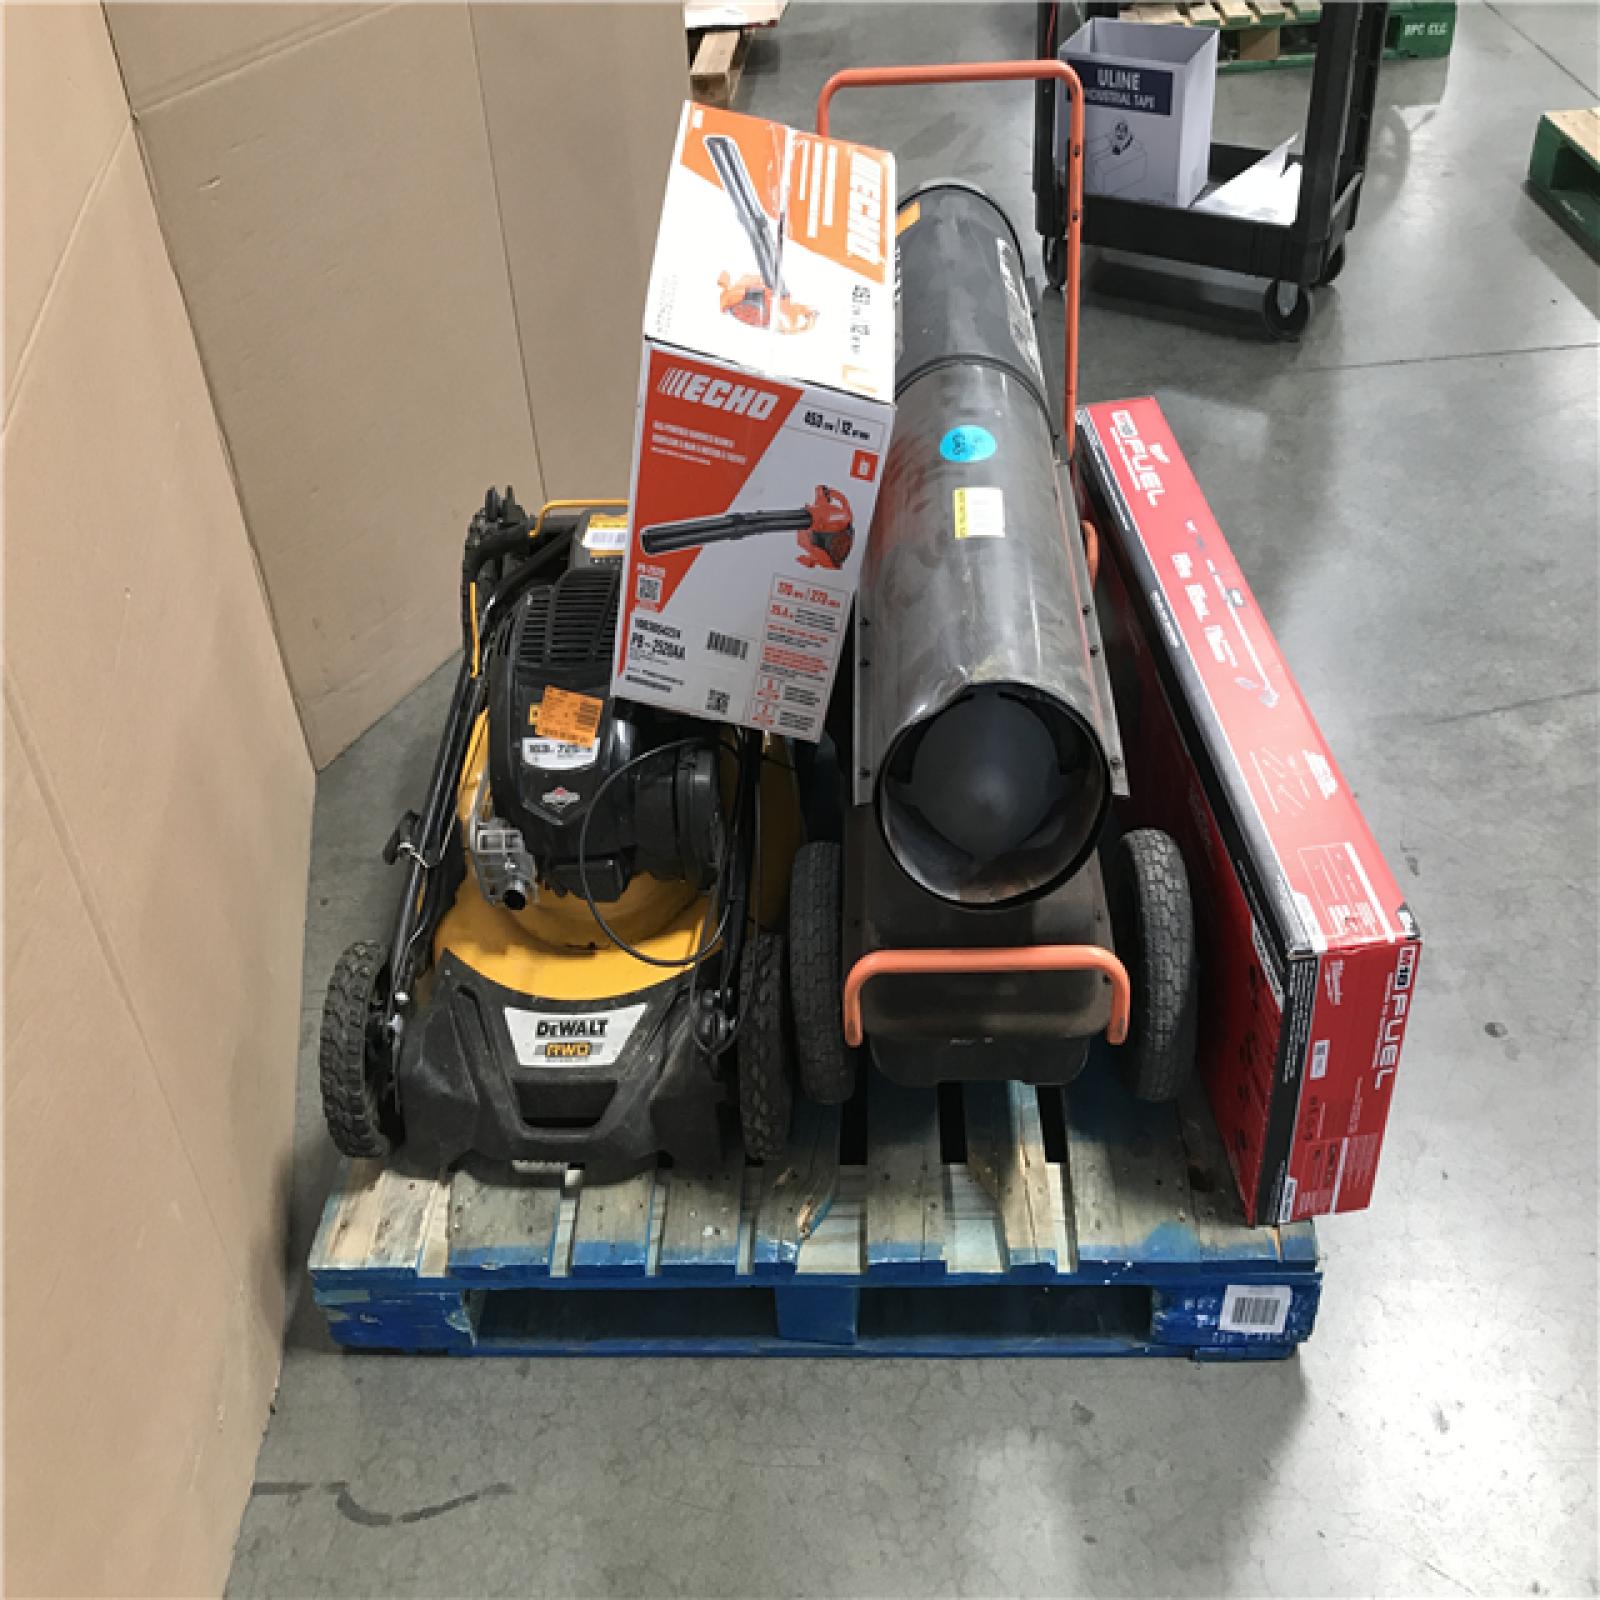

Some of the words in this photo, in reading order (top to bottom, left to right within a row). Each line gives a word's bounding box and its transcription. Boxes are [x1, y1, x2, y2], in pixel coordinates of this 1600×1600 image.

[1096, 68, 1141, 91] ULINE
[682, 374, 780, 421] ECHO
[804, 410, 823, 428] 453
[1124, 439, 1166, 507] FUEL
[1394, 946, 1416, 990] M18
[1374, 994, 1409, 1090] FUEL
